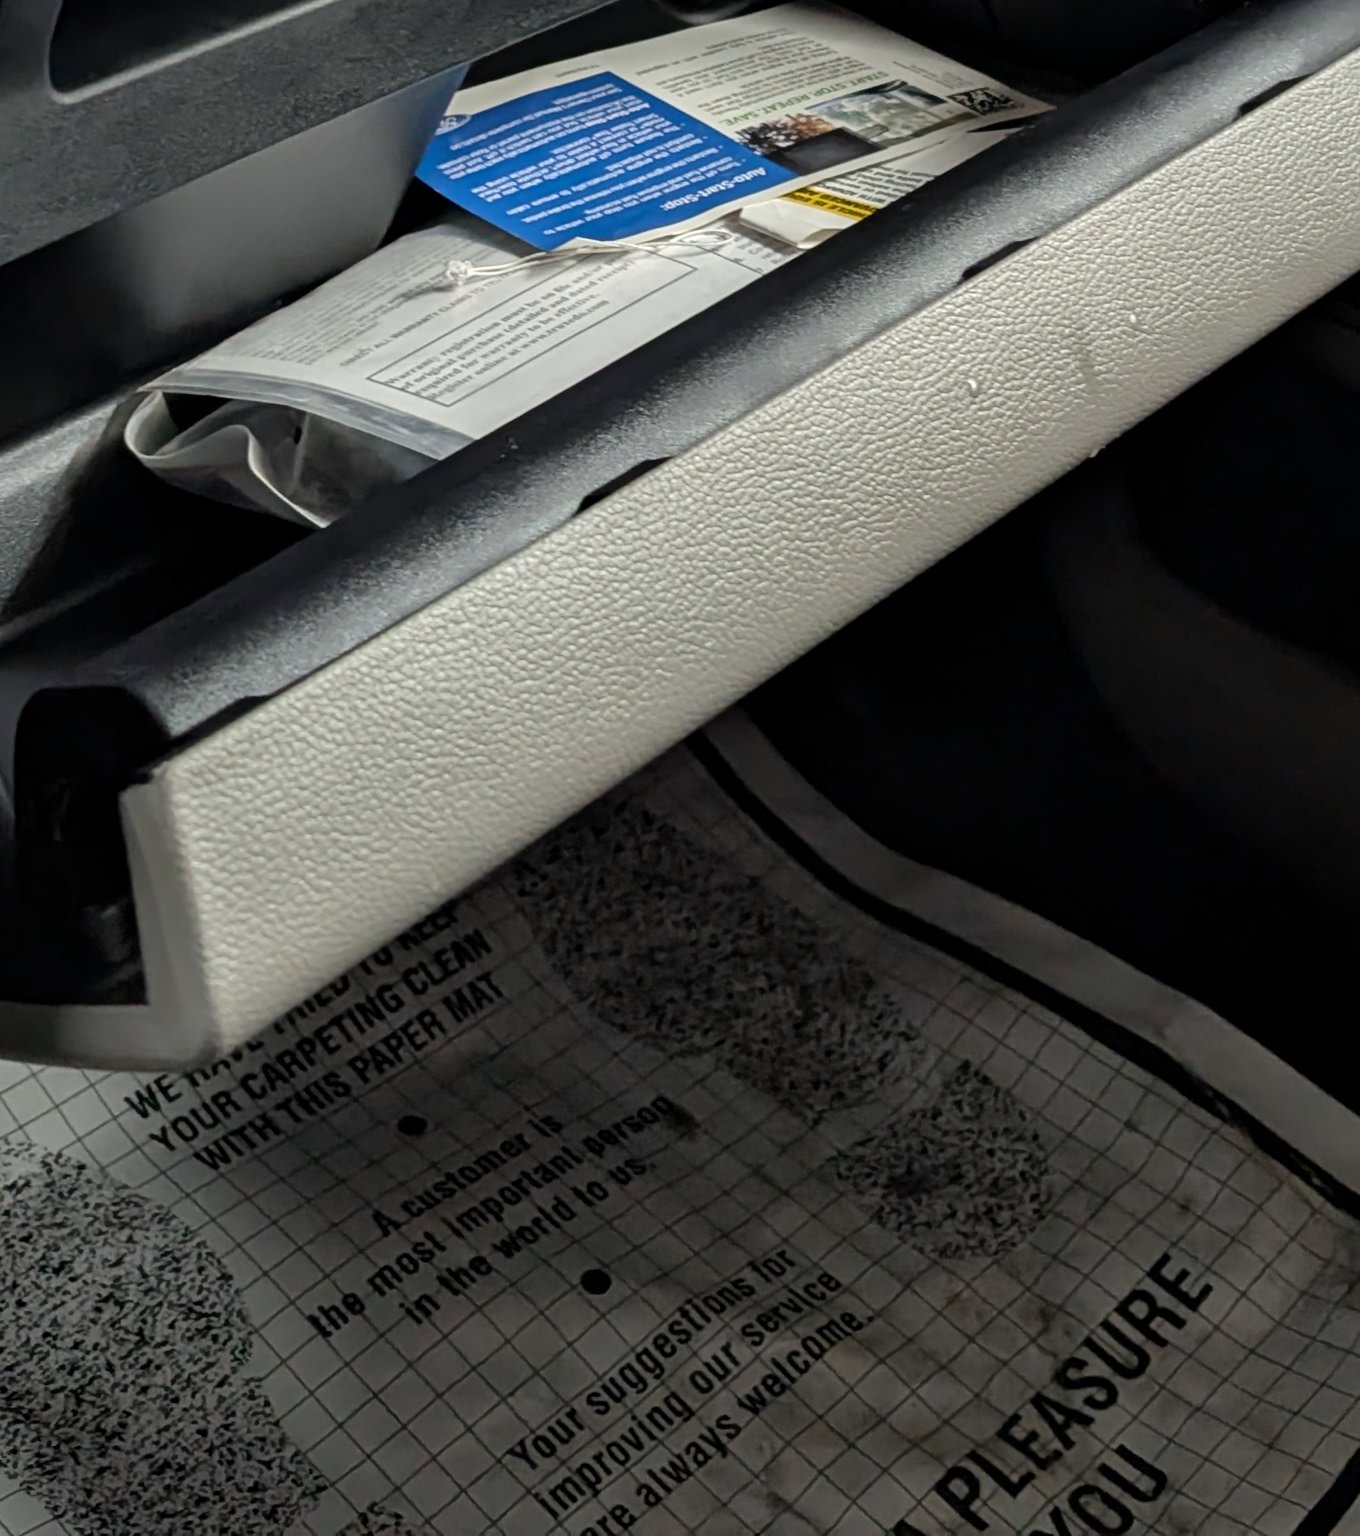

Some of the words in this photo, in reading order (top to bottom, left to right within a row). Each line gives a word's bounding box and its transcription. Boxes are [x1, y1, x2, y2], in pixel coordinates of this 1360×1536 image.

[660, 166, 766, 211] Auto-Start-Stop:
[125, 1077, 181, 1119] WE
[150, 1090, 242, 1151] YOUR
[239, 984, 404, 1100] CARPETING
[401, 928, 492, 996] CLEAN
[194, 1113, 282, 1170] WITH
[275, 1072, 352, 1123] THIS
[346, 1009, 446, 1084] PAPER
[442, 970, 503, 1023] MAT
[306, 1292, 366, 1338] the
[367, 1231, 446, 1296] most
[446, 1146, 584, 1238] important
[582, 1096, 679, 1158] person
[372, 1210, 401, 1236] A
[400, 1133, 531, 1218] customer
[533, 1115, 564, 1138] is
[399, 1294, 440, 1325] in
[436, 1255, 494, 1296] the
[494, 1198, 576, 1259] world
[572, 1180, 609, 1208] to
[608, 1157, 656, 1185] us.
[506, 1408, 584, 1469] Your
[586, 1278, 756, 1416] suggestions
[748, 1250, 796, 1283] for
[533, 1391, 696, 1519] improving
[689, 1342, 740, 1395] our
[741, 1272, 842, 1346] service
[636, 1414, 742, 1508] always
[737, 1312, 875, 1416] welcome.
[936, 1251, 1218, 1533] PLEASURE
